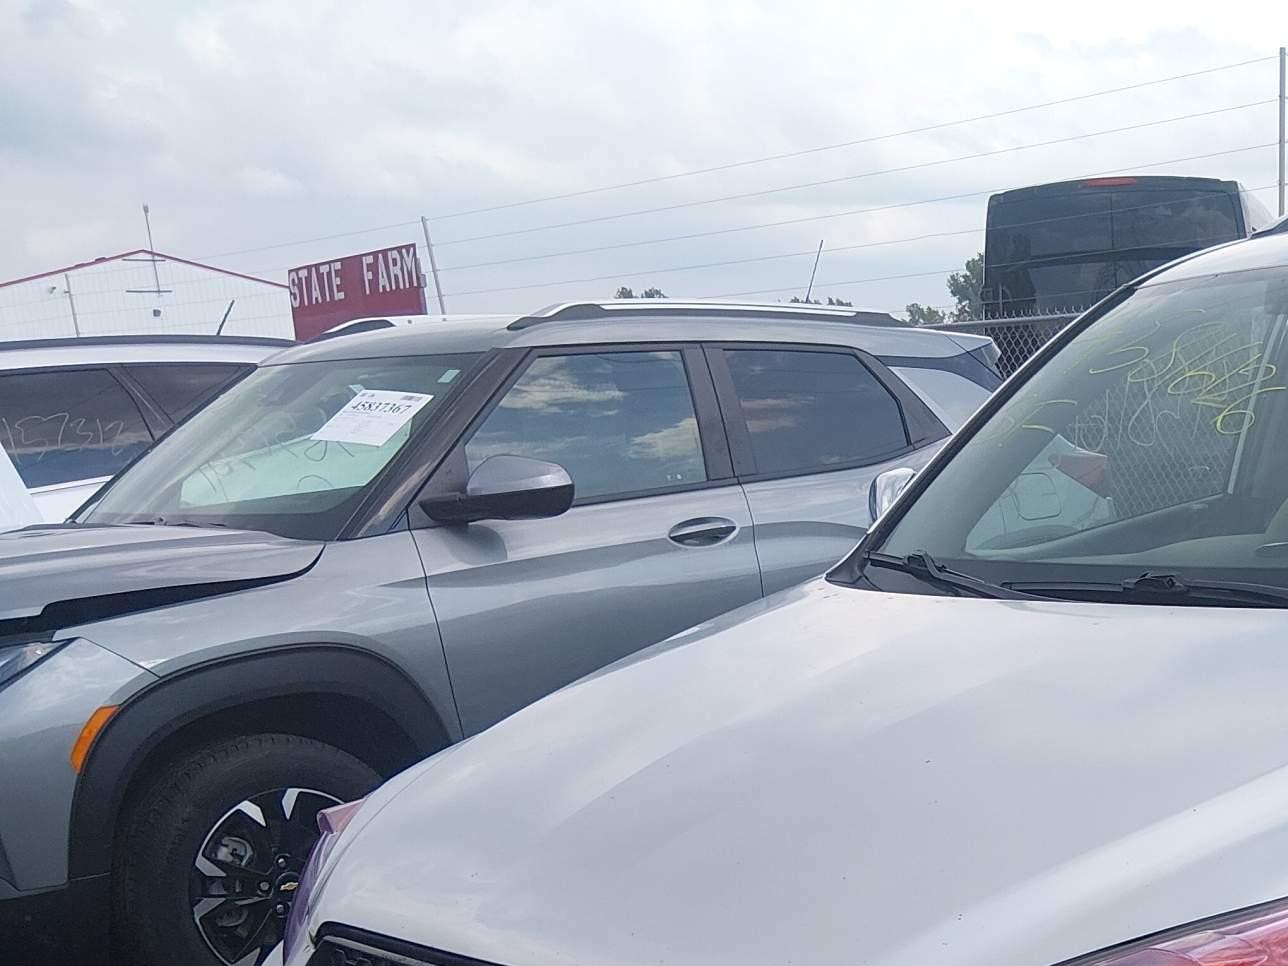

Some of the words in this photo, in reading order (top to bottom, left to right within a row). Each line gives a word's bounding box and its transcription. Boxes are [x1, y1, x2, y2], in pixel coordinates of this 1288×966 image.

[289, 261, 345, 308] STATE
[362, 247, 418, 295] FARM
[352, 401, 412, 414] 45837367
